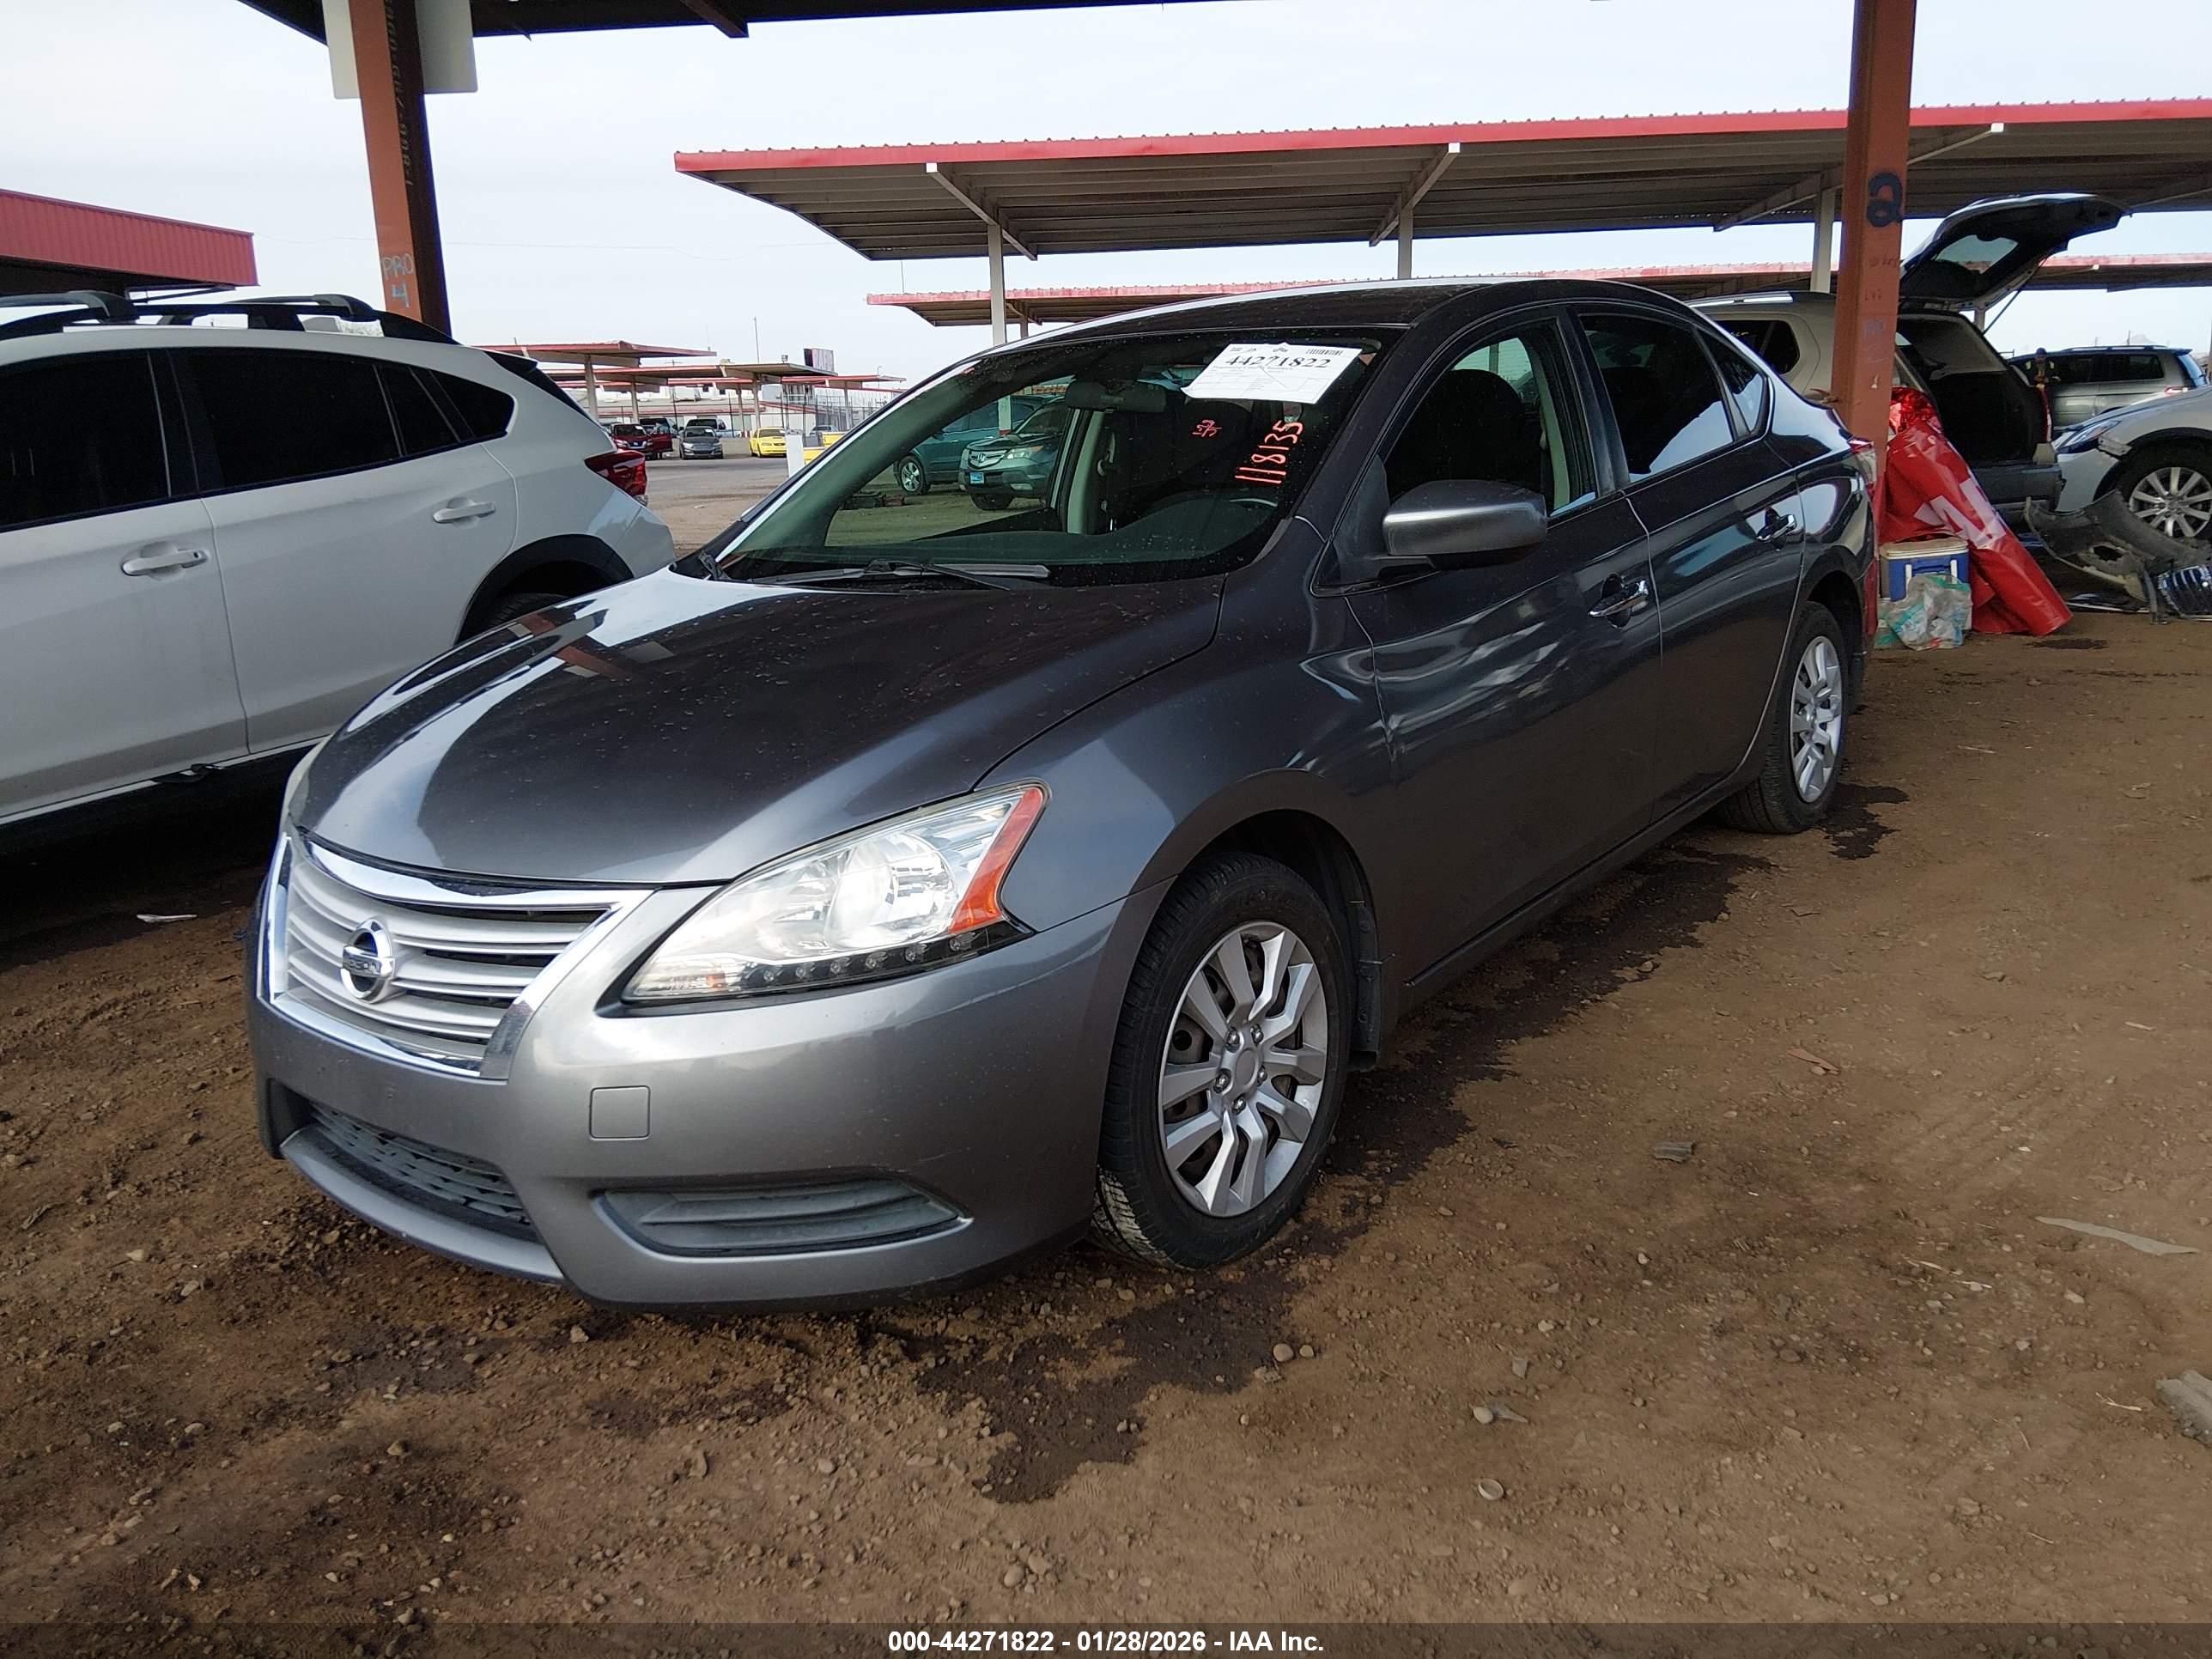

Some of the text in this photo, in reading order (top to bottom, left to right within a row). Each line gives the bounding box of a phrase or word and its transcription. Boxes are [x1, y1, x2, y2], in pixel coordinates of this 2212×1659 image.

[381, 253, 414, 281] PRO
[391, 282, 410, 308] 4
[1225, 356, 1331, 368] 44271822
[1234, 420, 1304, 484] 118135
